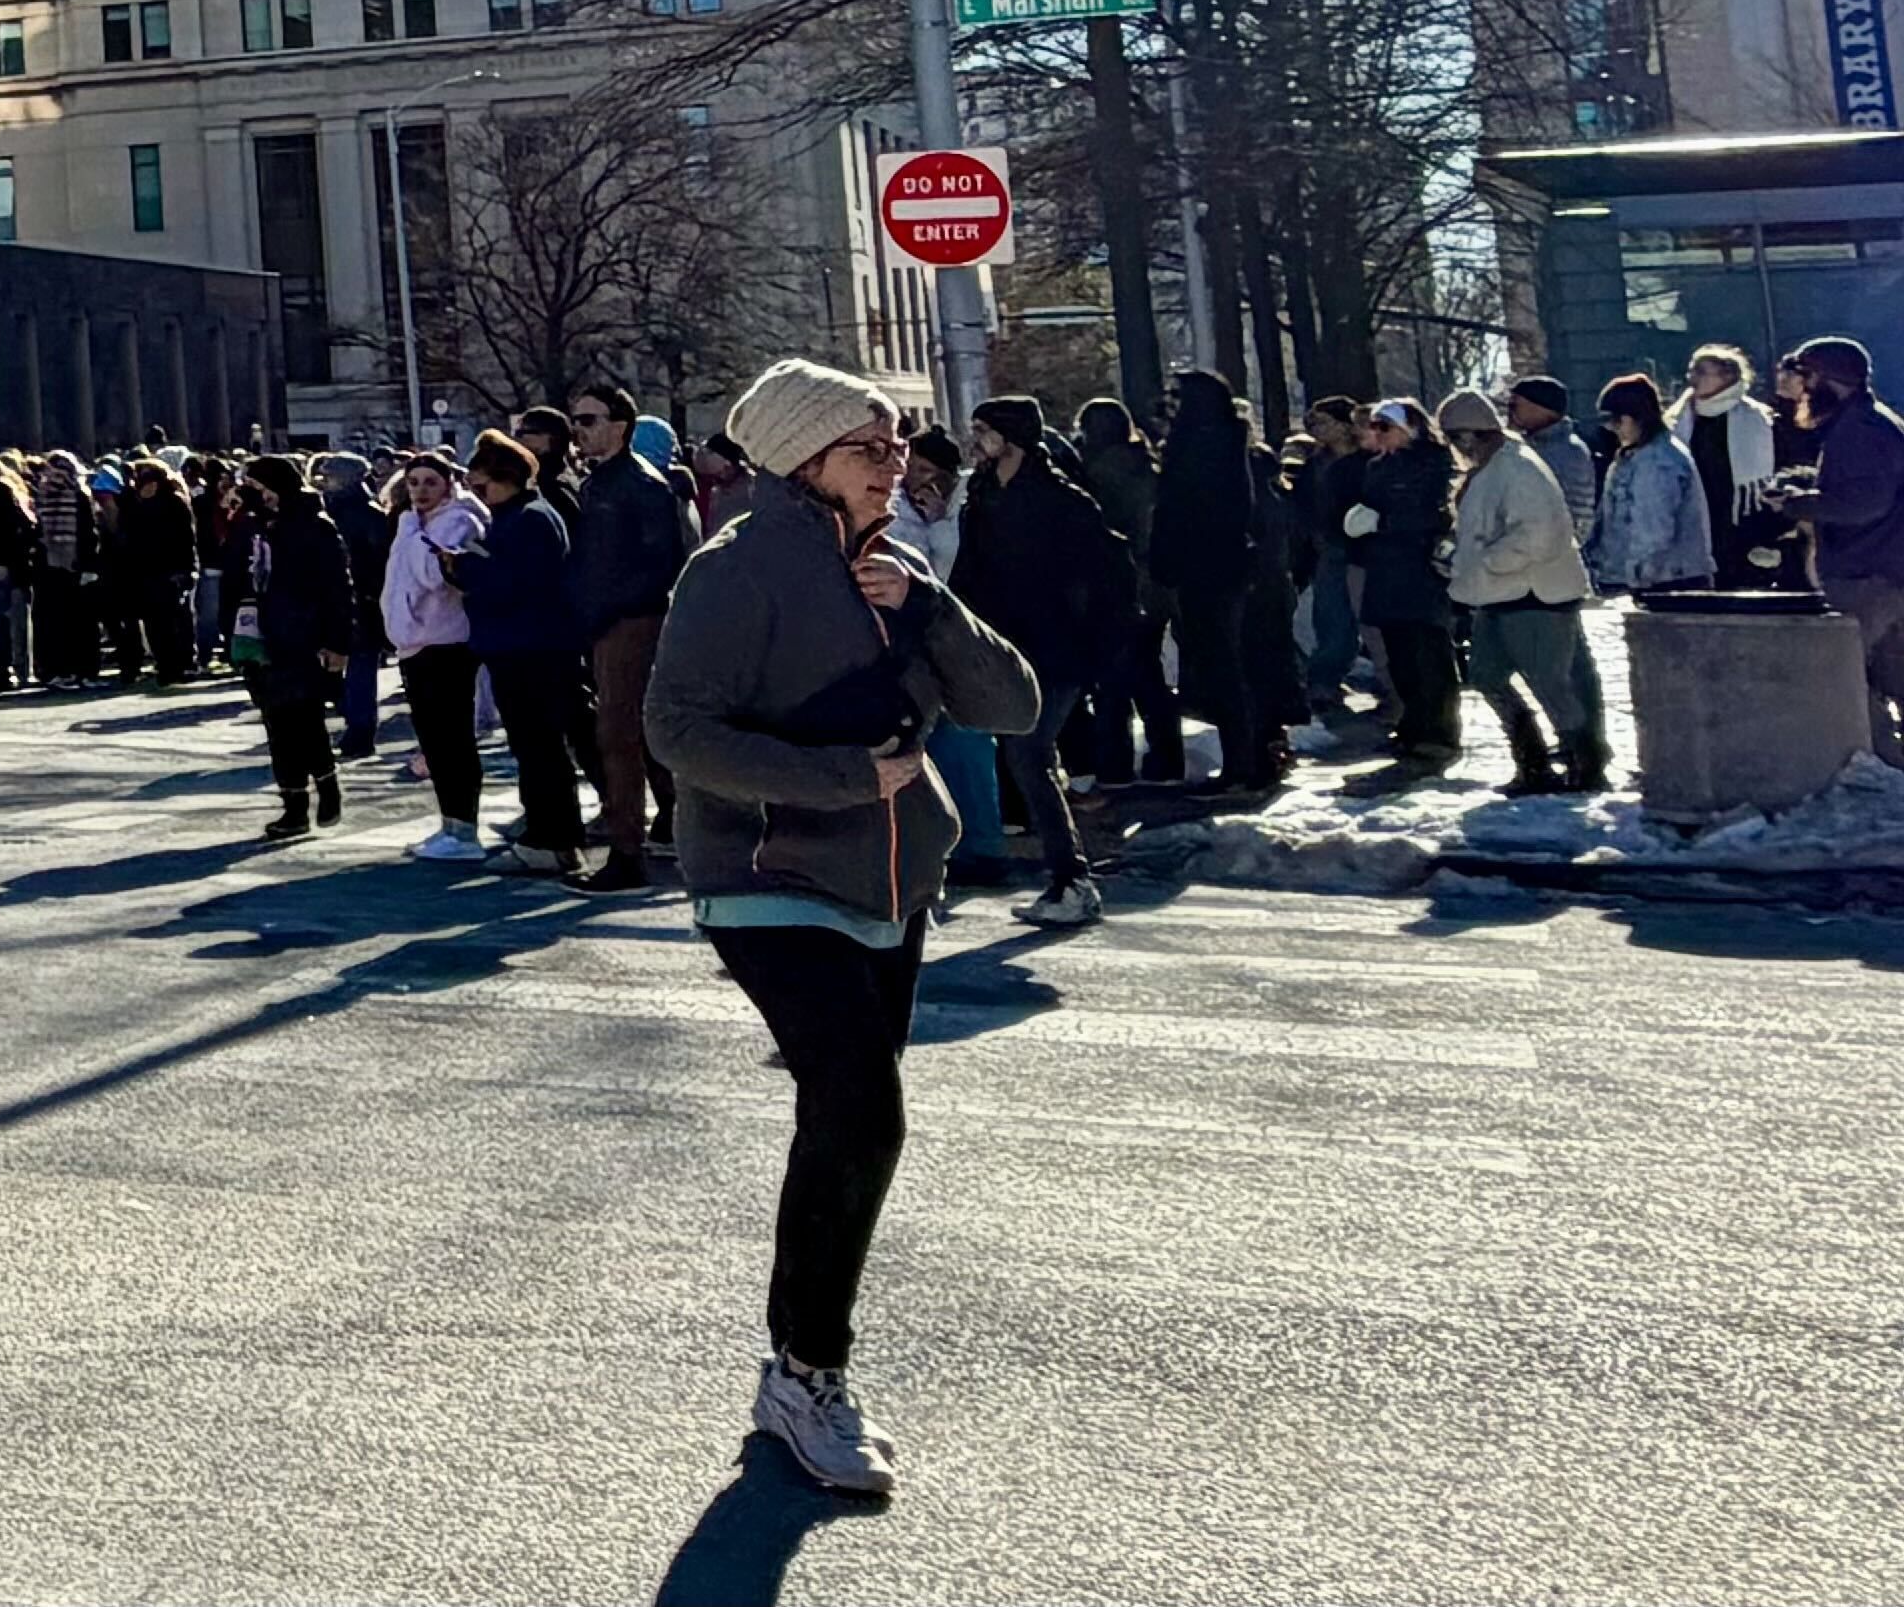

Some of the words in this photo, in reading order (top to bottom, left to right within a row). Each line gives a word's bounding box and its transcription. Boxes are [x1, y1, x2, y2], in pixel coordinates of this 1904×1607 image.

[902, 176, 933, 194] DO
[941, 173, 984, 193] NOT
[912, 222, 980, 243] ENTER
